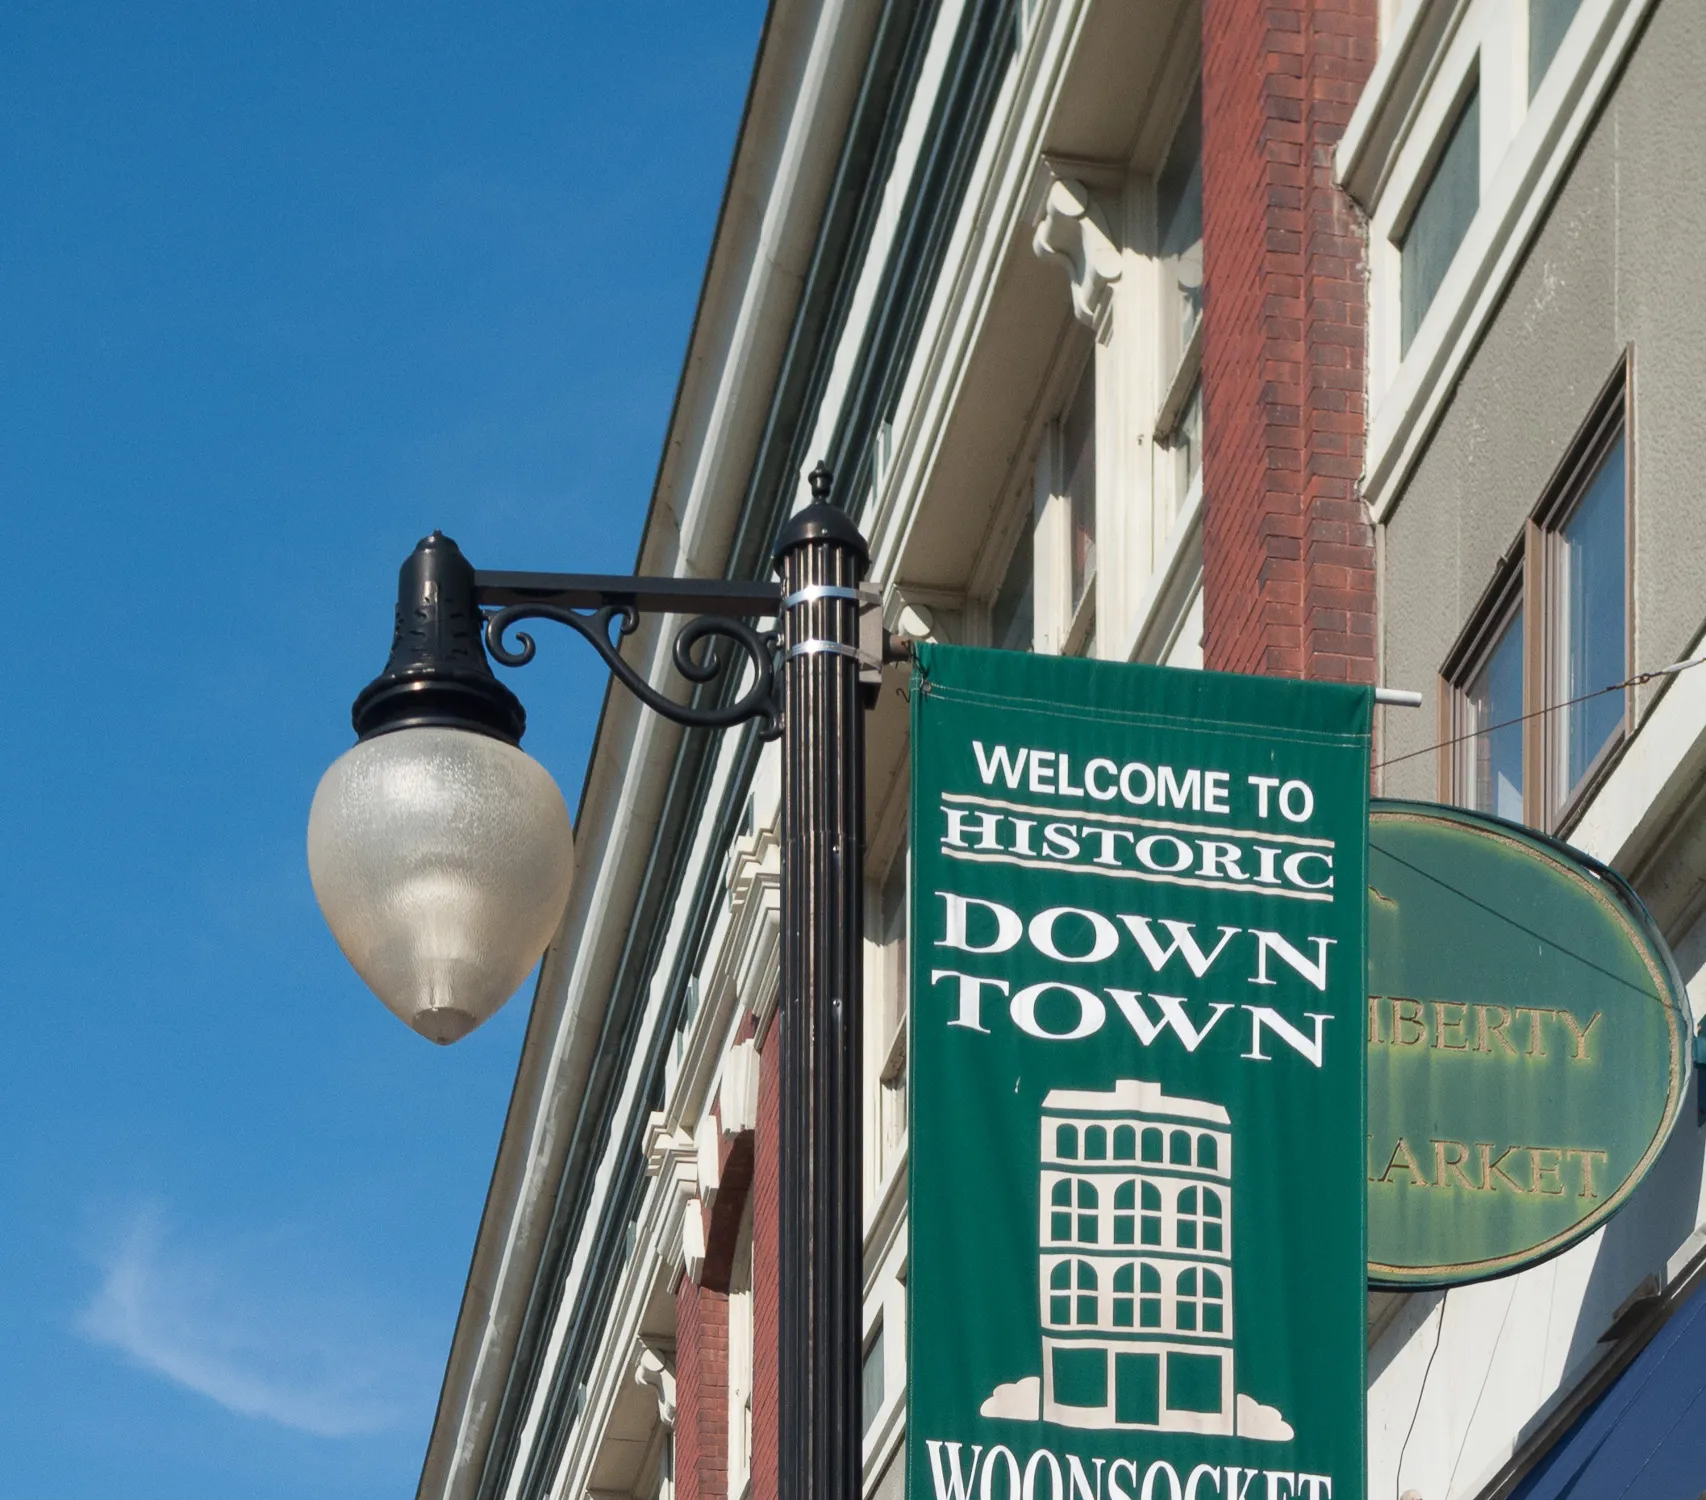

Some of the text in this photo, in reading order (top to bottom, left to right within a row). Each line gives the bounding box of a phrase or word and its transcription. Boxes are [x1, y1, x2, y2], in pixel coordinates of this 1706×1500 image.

[972, 741, 1314, 822] WELCOME TO
[940, 806, 1334, 888] HISTORIC
[934, 891, 1337, 992] DOWN
[931, 969, 1335, 1068] TOWN
[1368, 995, 1601, 1060] IBERTY
[1367, 1134, 1606, 1198] ARKET
